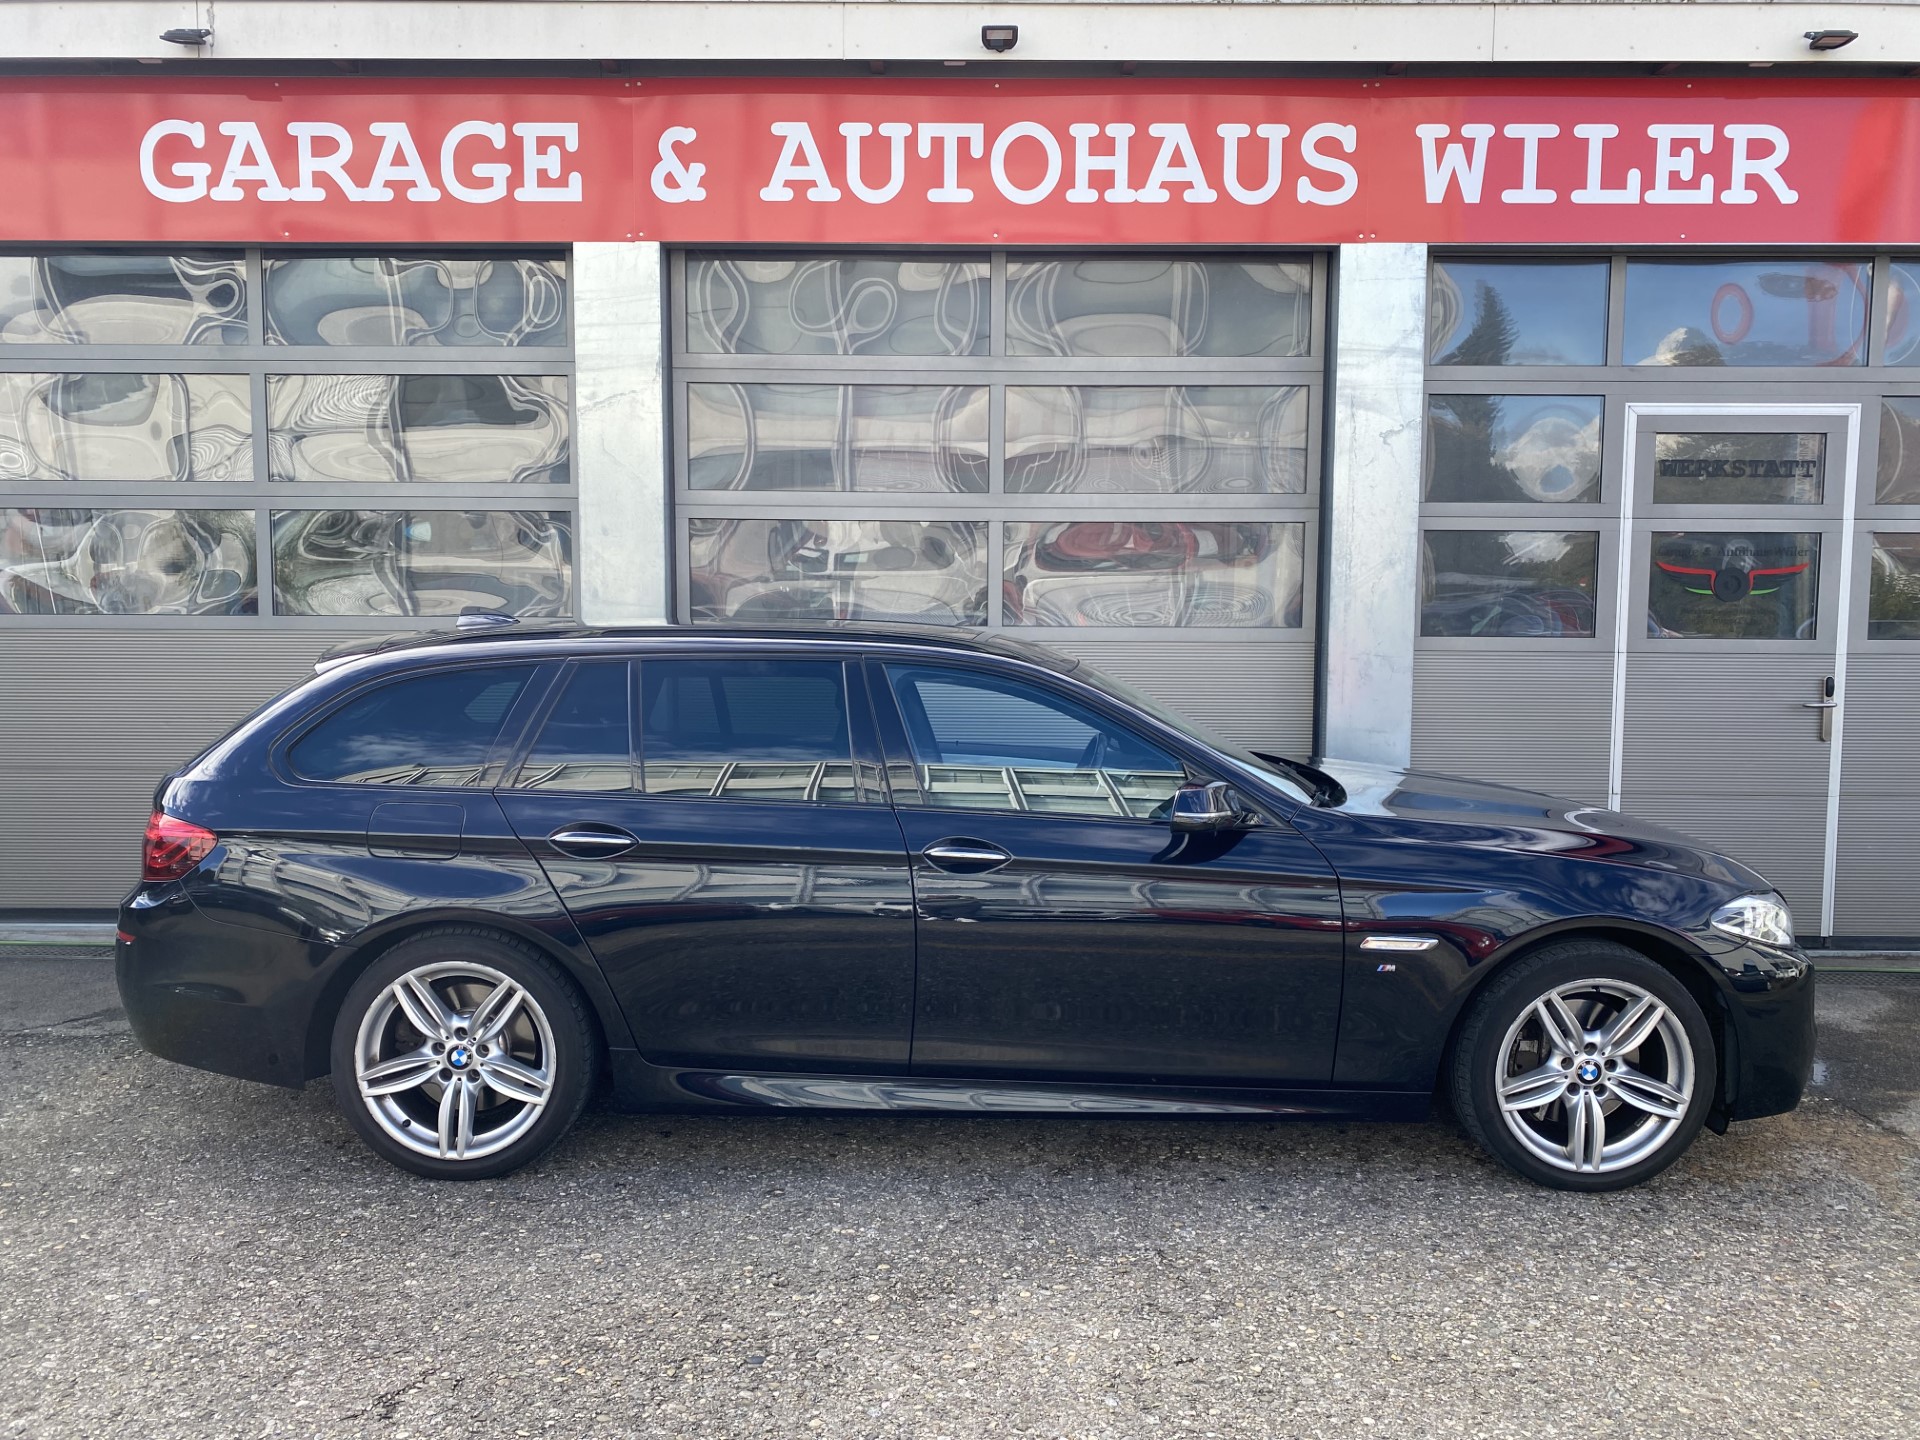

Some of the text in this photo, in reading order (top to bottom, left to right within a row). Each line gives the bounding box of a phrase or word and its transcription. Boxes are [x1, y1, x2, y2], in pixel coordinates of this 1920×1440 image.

[140, 120, 1798, 205] GARAGE & AUTOHAUS WILER
[1658, 459, 1816, 478] WERKSTATT
